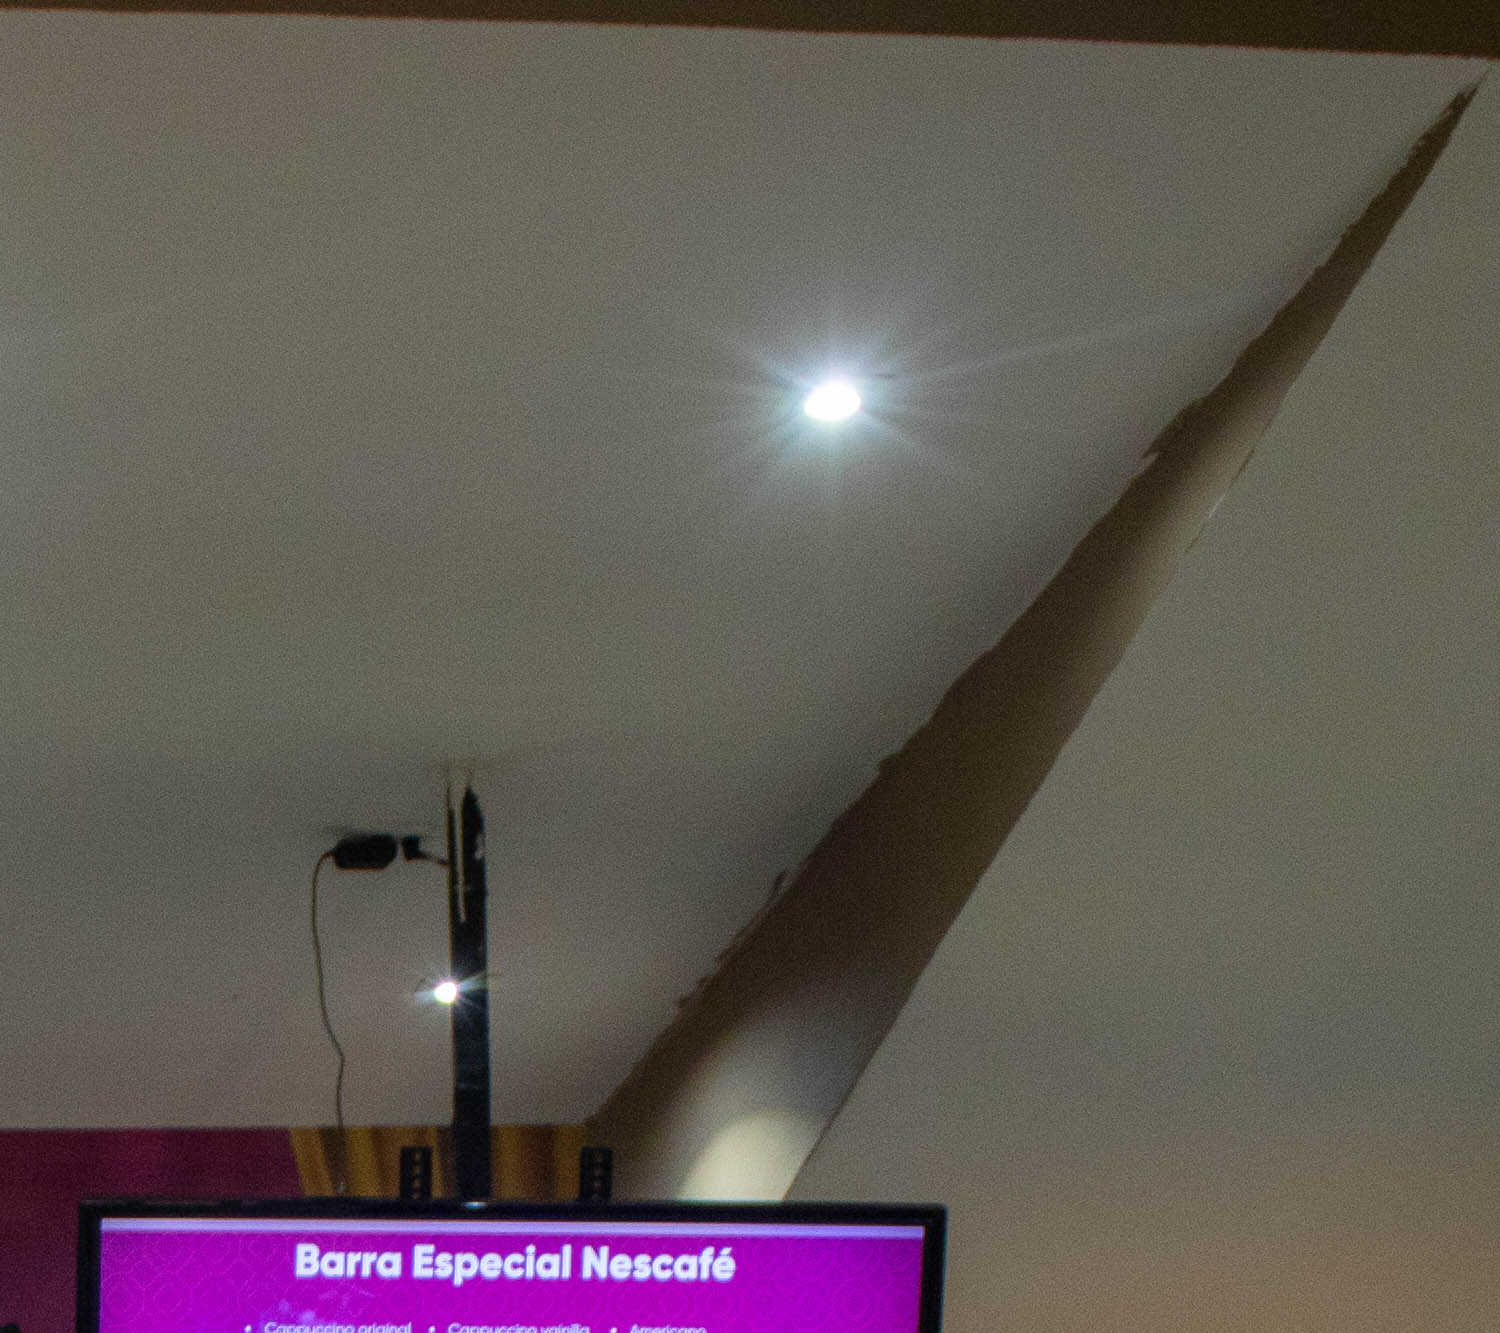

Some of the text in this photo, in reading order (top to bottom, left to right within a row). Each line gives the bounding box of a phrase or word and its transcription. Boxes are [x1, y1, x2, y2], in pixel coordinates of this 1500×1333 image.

[295, 1243, 736, 1286] Barra Especial Nescafé
